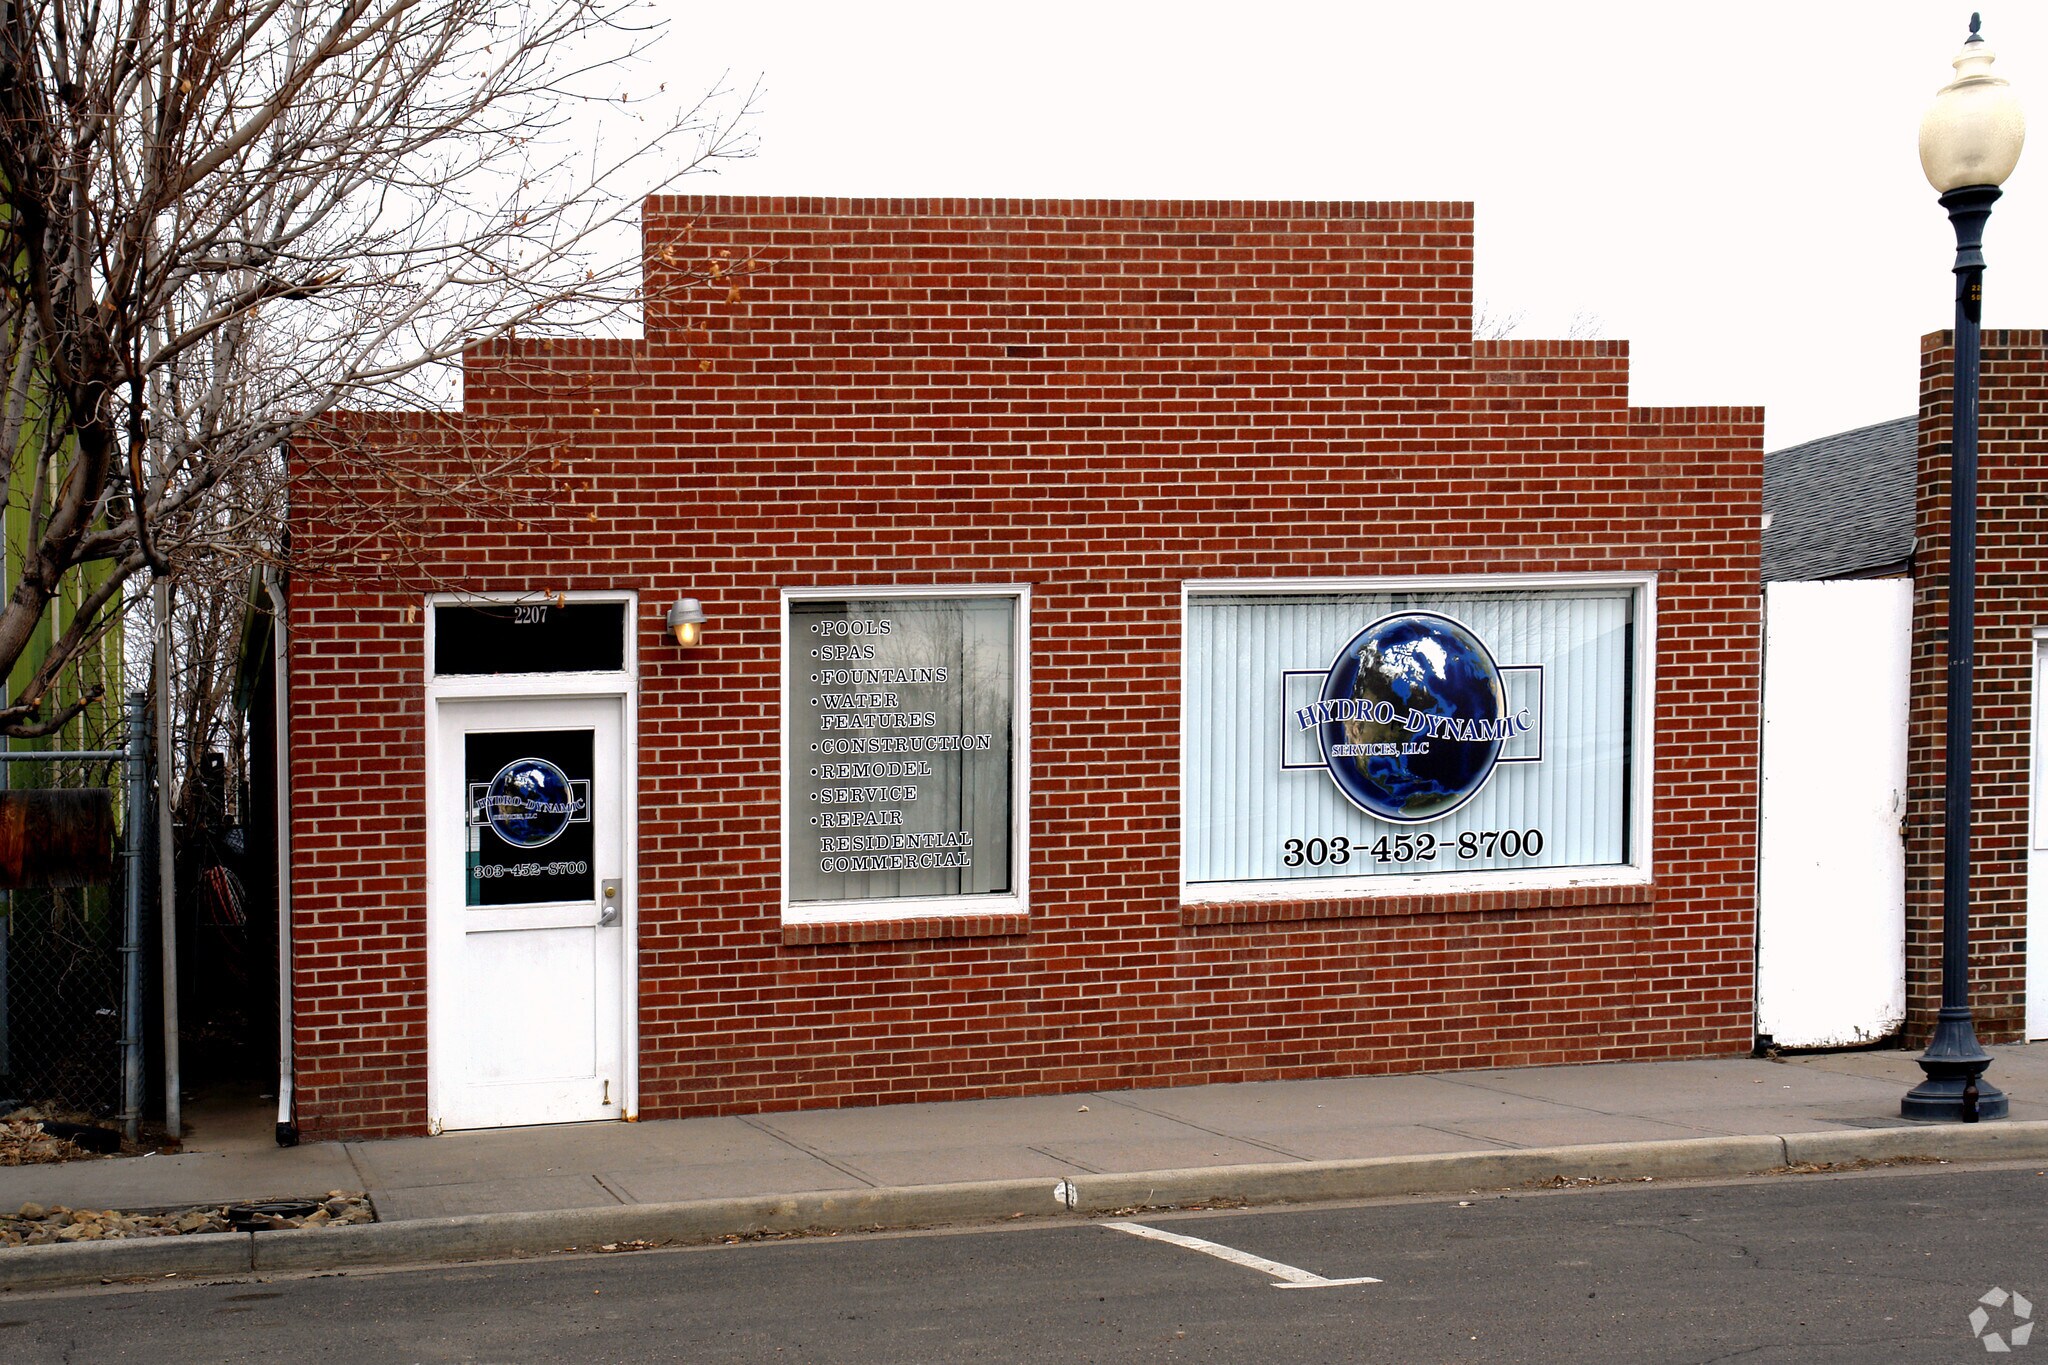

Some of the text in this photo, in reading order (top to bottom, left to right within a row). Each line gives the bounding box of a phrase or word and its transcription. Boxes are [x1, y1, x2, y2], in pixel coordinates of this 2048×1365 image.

[514, 605, 548, 624] 2207
[821, 619, 892, 637] POOLS
[821, 645, 875, 661] SPAS
[821, 667, 948, 685] FOUNTAINS
[821, 692, 899, 709] WATER
[821, 712, 936, 730] FEATURES
[1295, 698, 1535, 741] HYDRO-DYNAMIC
[821, 734, 992, 754] CONSTRUCTION
[1331, 742, 1430, 757] SERVICES, LLC
[821, 761, 932, 779] REMODEL
[476, 795, 585, 813] HYDRO-DYNAMIC
[821, 786, 917, 804] SERVICE
[821, 810, 903, 827] REPAIR
[821, 832, 973, 852] RESIDENTIAL
[1283, 829, 1544, 867] 303-452-8700
[474, 861, 587, 878] 303-452-8700
[821, 852, 971, 873] COMMERCIAL
